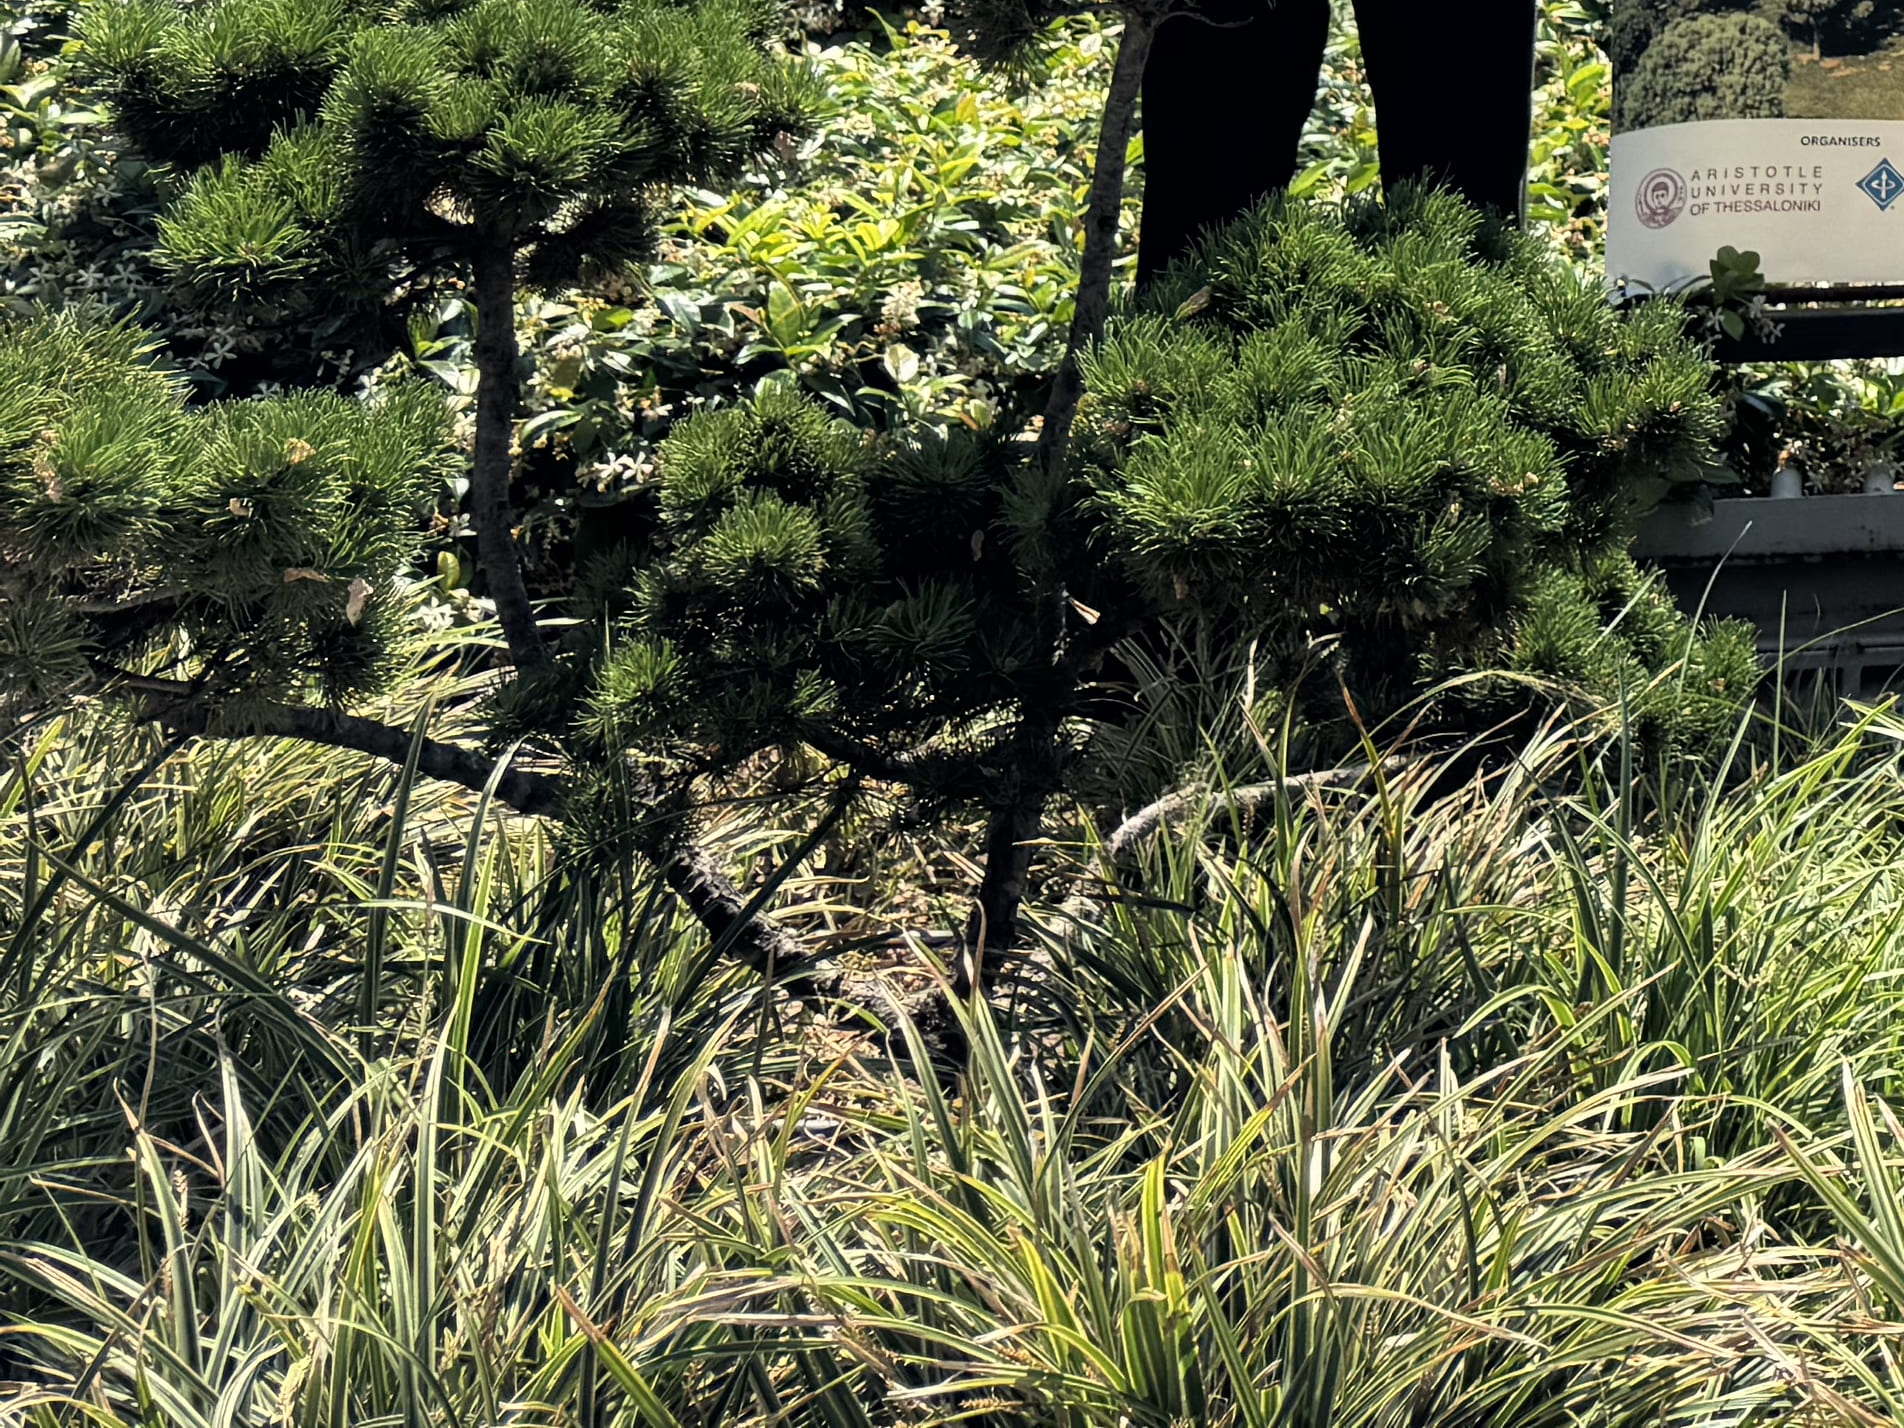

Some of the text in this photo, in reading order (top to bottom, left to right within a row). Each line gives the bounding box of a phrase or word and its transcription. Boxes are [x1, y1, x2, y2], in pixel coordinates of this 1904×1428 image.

[1800, 135, 1881, 147] ORGANISERS
[1691, 166, 1823, 182] ARISTOTLE
[1691, 182, 1824, 199] UNIVERSITY
[1690, 199, 1822, 216] OF THESSALONIKI
